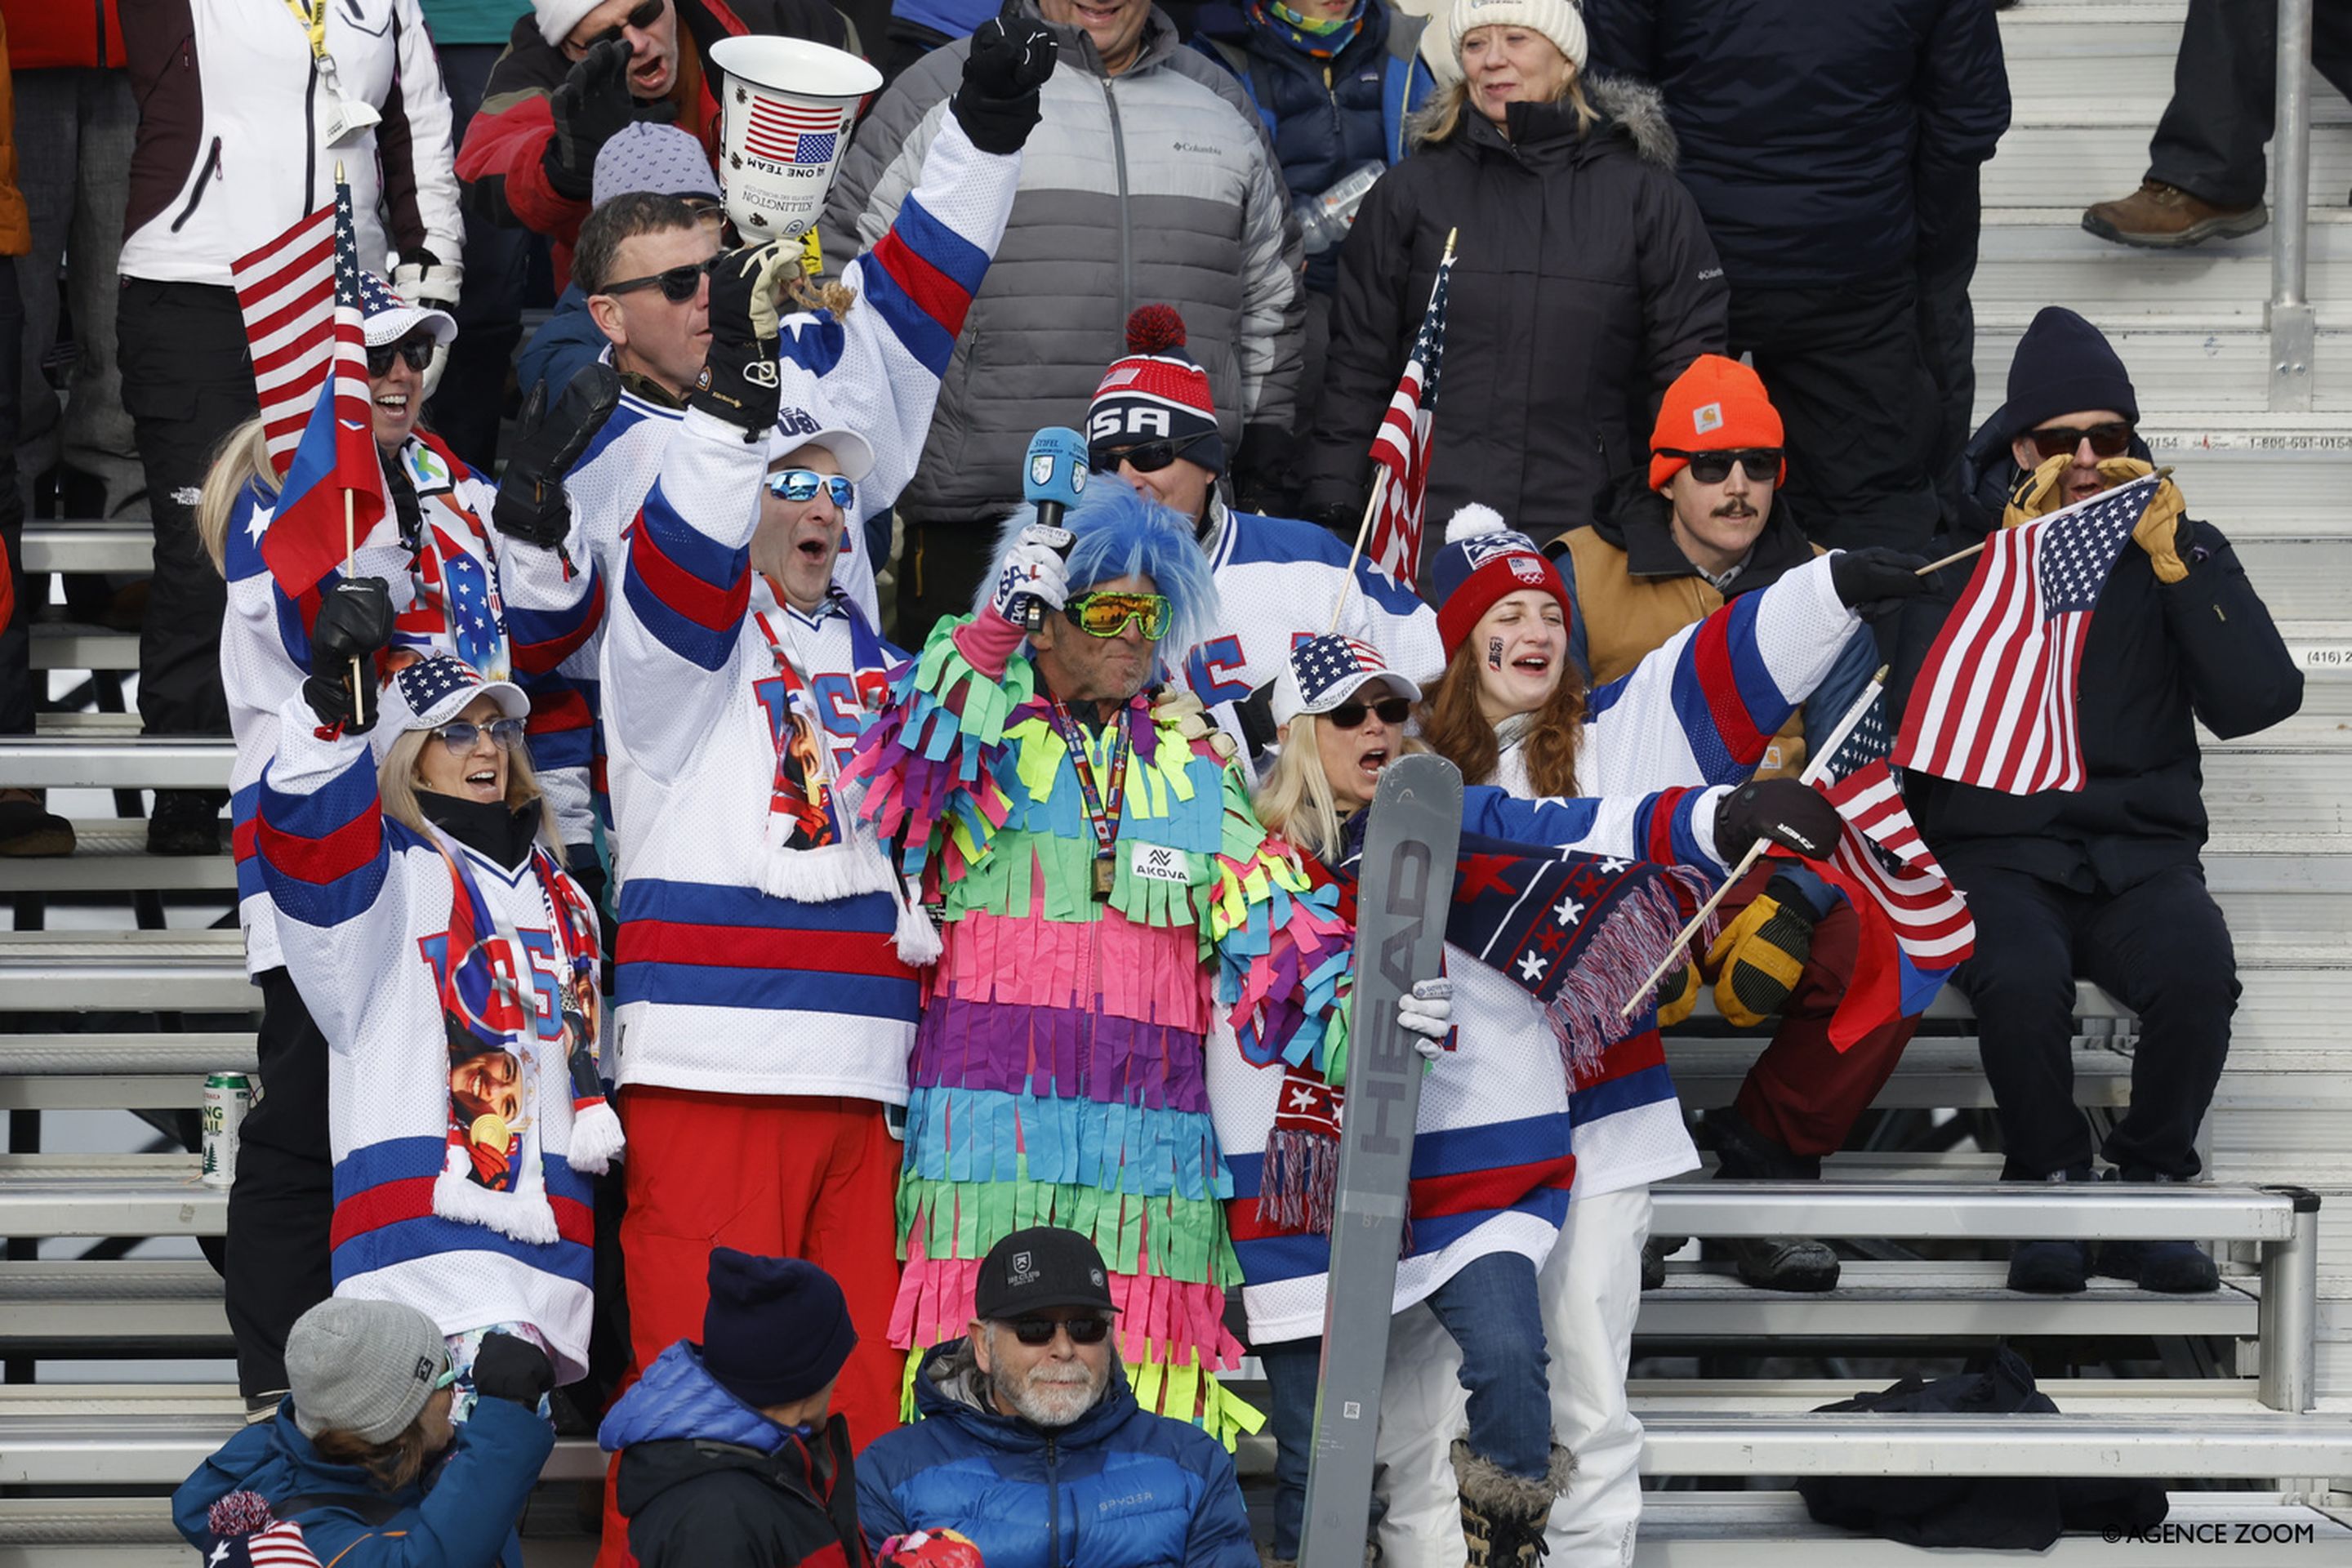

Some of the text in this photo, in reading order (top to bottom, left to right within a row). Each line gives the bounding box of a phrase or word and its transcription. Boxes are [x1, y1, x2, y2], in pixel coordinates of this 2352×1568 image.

[1182, 141, 1223, 156] Columbia
[746, 157, 815, 178] ONE TEAM
[742, 190, 814, 213] KILLINGTON
[777, 415, 823, 437] USA
[1087, 407, 1170, 443] SA
[2307, 651, 2341, 665] (416)
[1136, 865, 1188, 881] AKOVA
[1361, 839, 1432, 1155] HEAD
[1098, 1491, 1153, 1512] SPYDER
